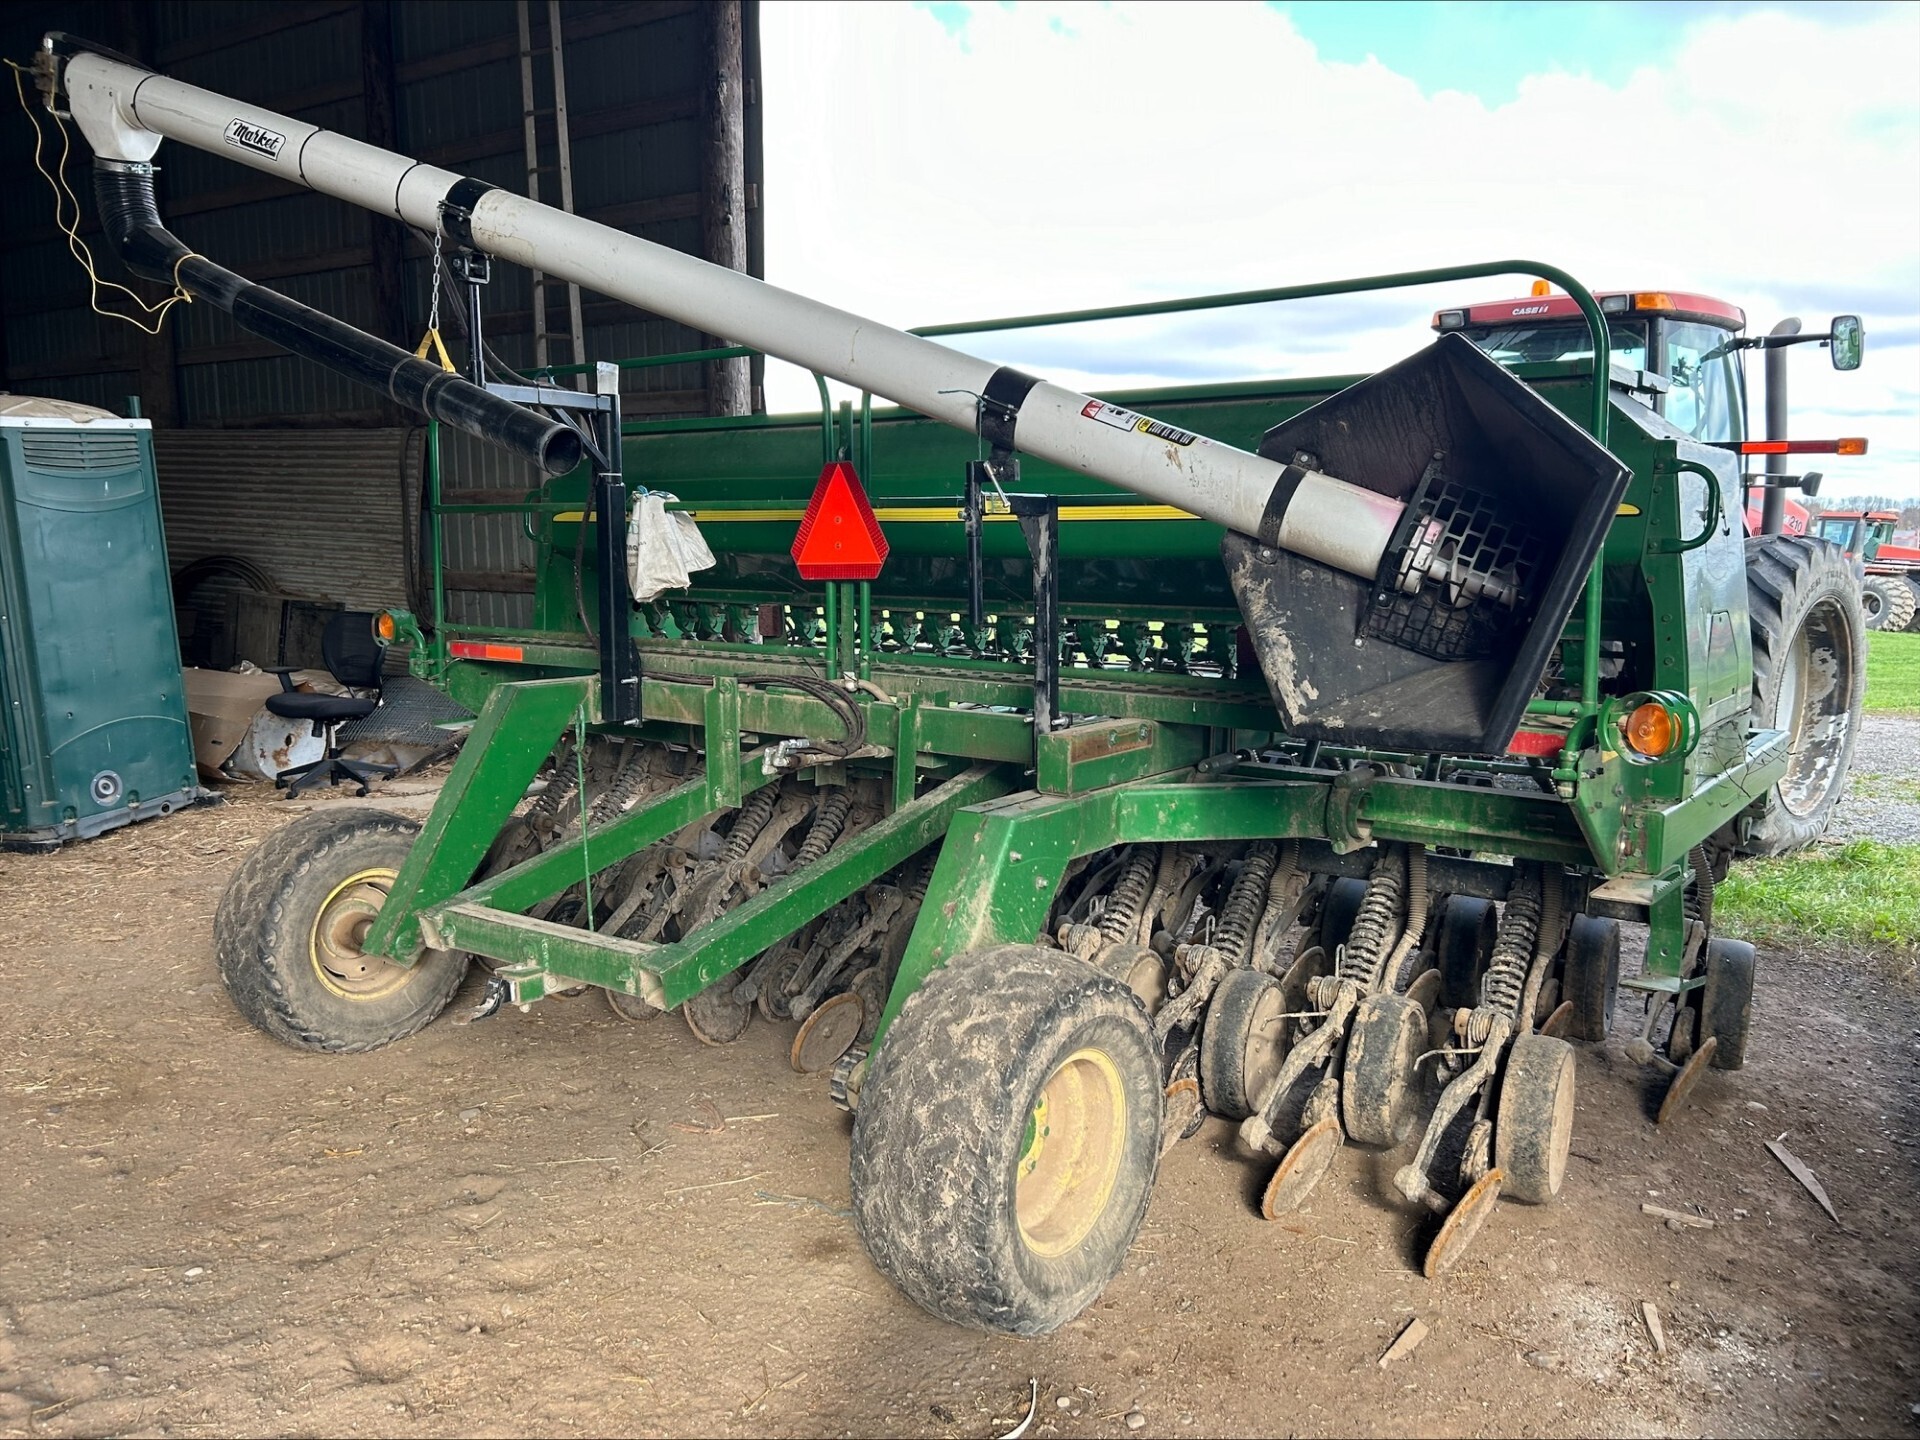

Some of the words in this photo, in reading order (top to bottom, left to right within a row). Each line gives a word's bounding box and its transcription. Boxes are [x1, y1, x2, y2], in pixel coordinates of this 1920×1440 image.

[233, 121, 279, 151] Market
[1512, 306, 1539, 316] CASE
[1789, 515, 1803, 533] 210
